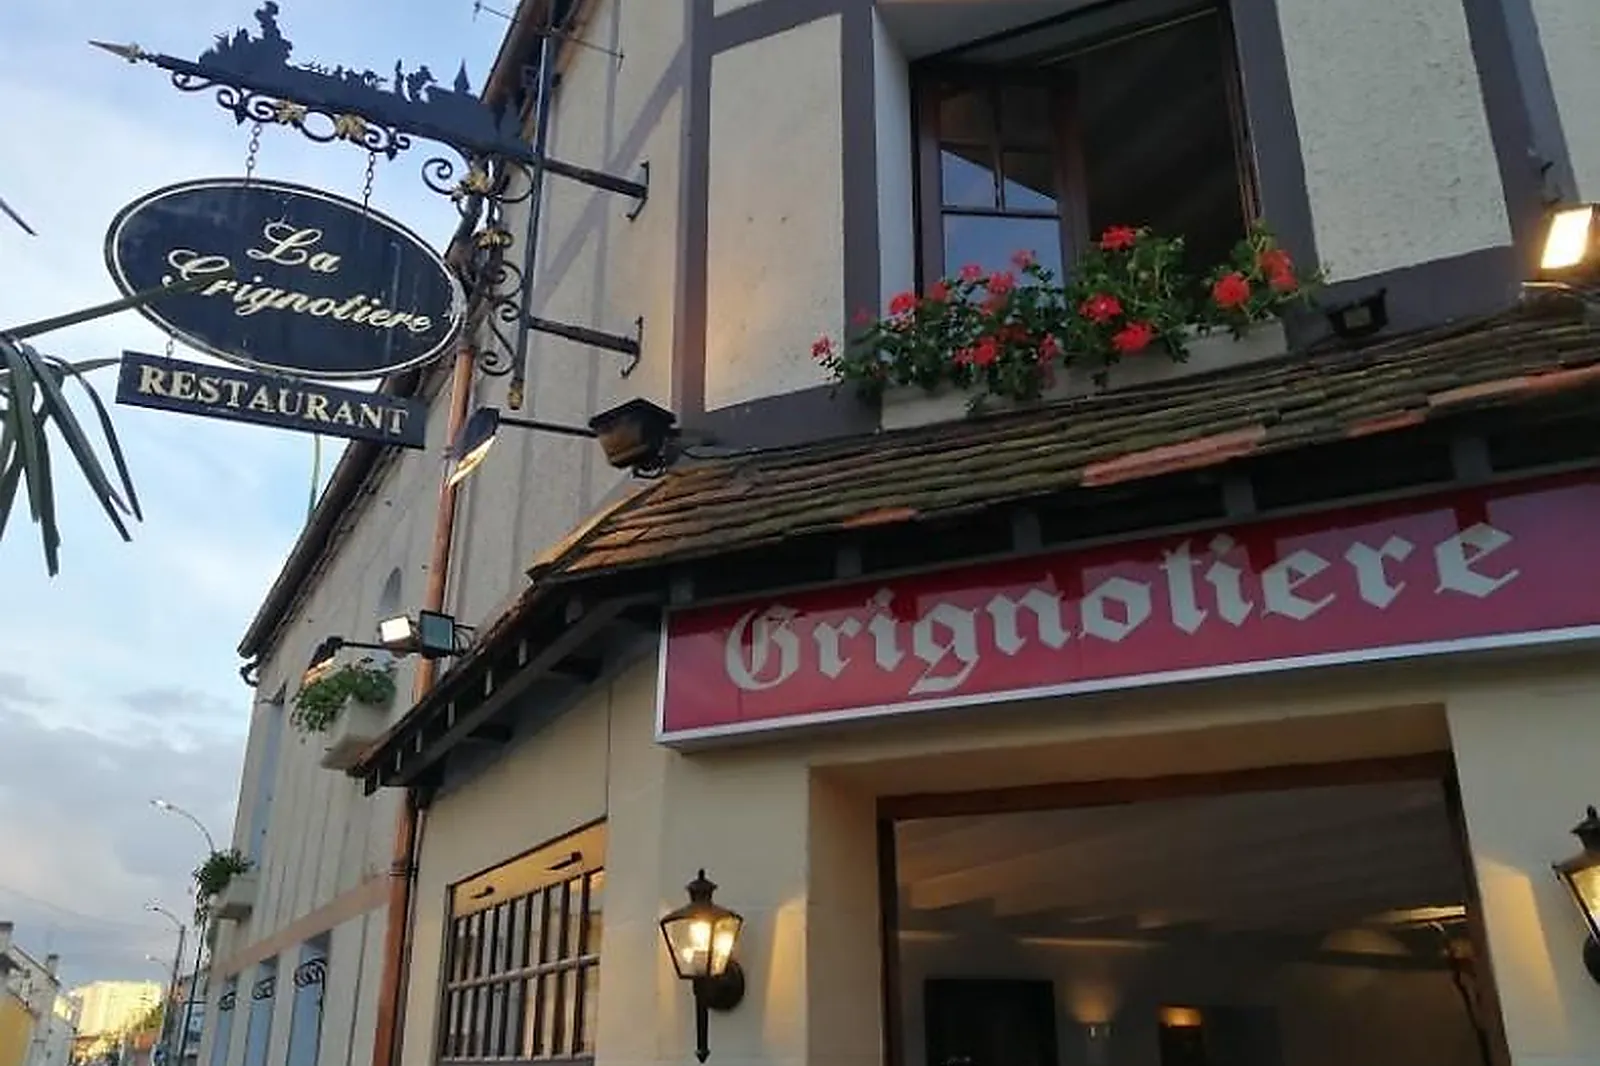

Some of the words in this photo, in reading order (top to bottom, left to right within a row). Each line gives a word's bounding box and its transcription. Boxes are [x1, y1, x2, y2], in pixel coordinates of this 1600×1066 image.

[246, 221, 341, 273] La
[137, 365, 409, 434] RESTAURANT
[725, 522, 1519, 695] Grignotiere
